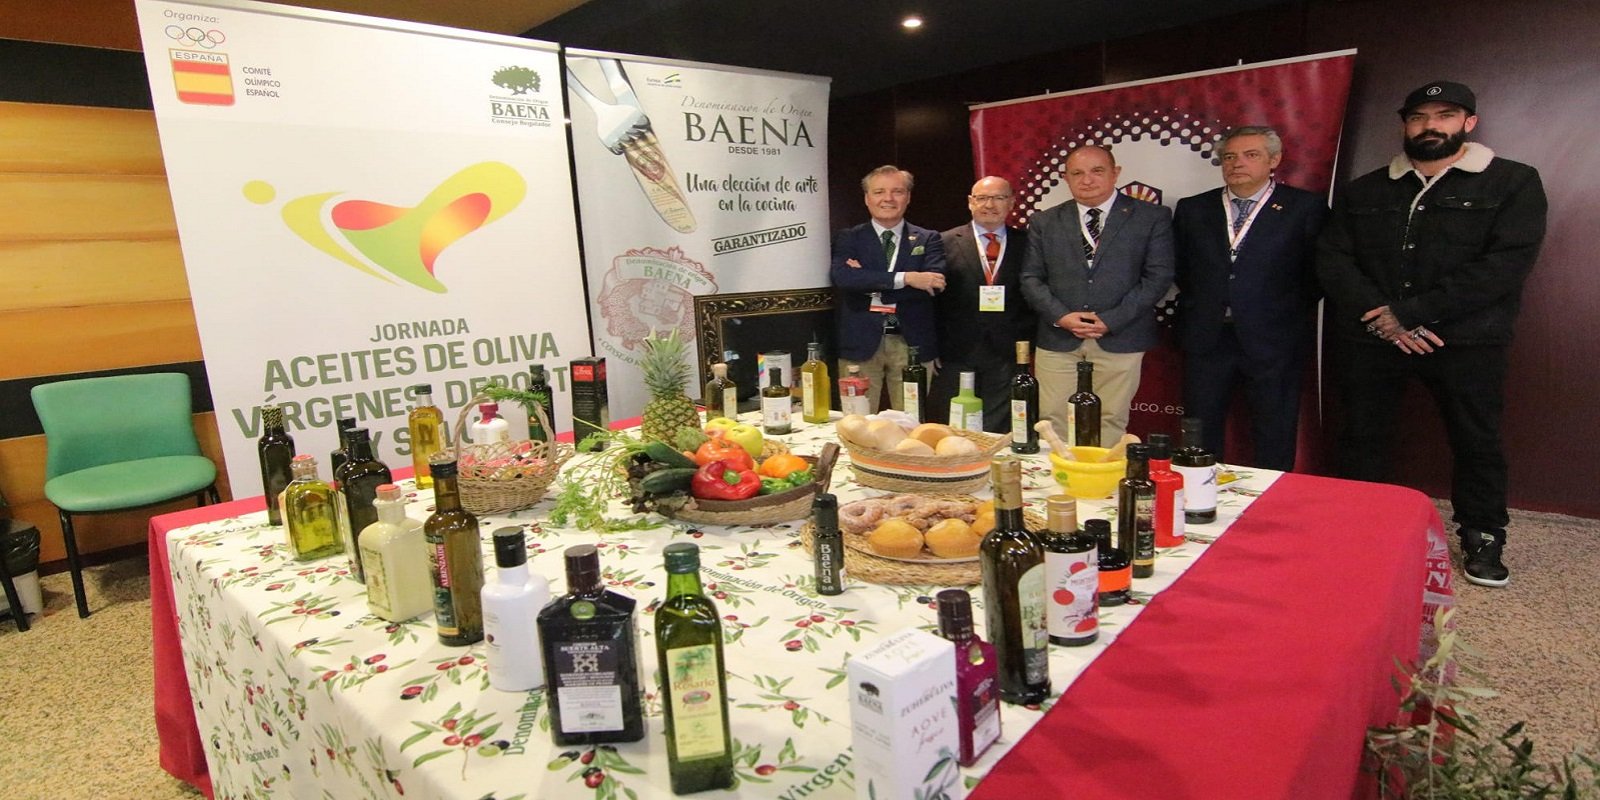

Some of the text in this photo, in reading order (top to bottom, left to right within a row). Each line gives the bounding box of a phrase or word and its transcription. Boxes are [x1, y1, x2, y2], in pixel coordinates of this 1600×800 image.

[163, 9, 220, 24] Organiza:
[175, 51, 223, 62] ESPAÑA
[244, 77, 281, 88] OLÍMPICO
[246, 88, 280, 98] ESPAÑOL
[491, 102, 550, 120] BAENA
[682, 112, 815, 148] BAENA
[728, 146, 781, 156] DESDE 1981
[686, 172, 818, 194] Una elección de arte
[718, 193, 796, 212] en la cocina
[713, 225, 807, 253] GARANTIZADO
[643, 265, 692, 290] BAENA
[370, 318, 470, 343] JORNADA
[264, 332, 560, 392] ACEITES DE OLIVA
[231, 386, 418, 439] VRGENES
[820, 543, 832, 584] Baena
[782, 587, 827, 609] Origen
[673, 679, 716, 691] Rosario
